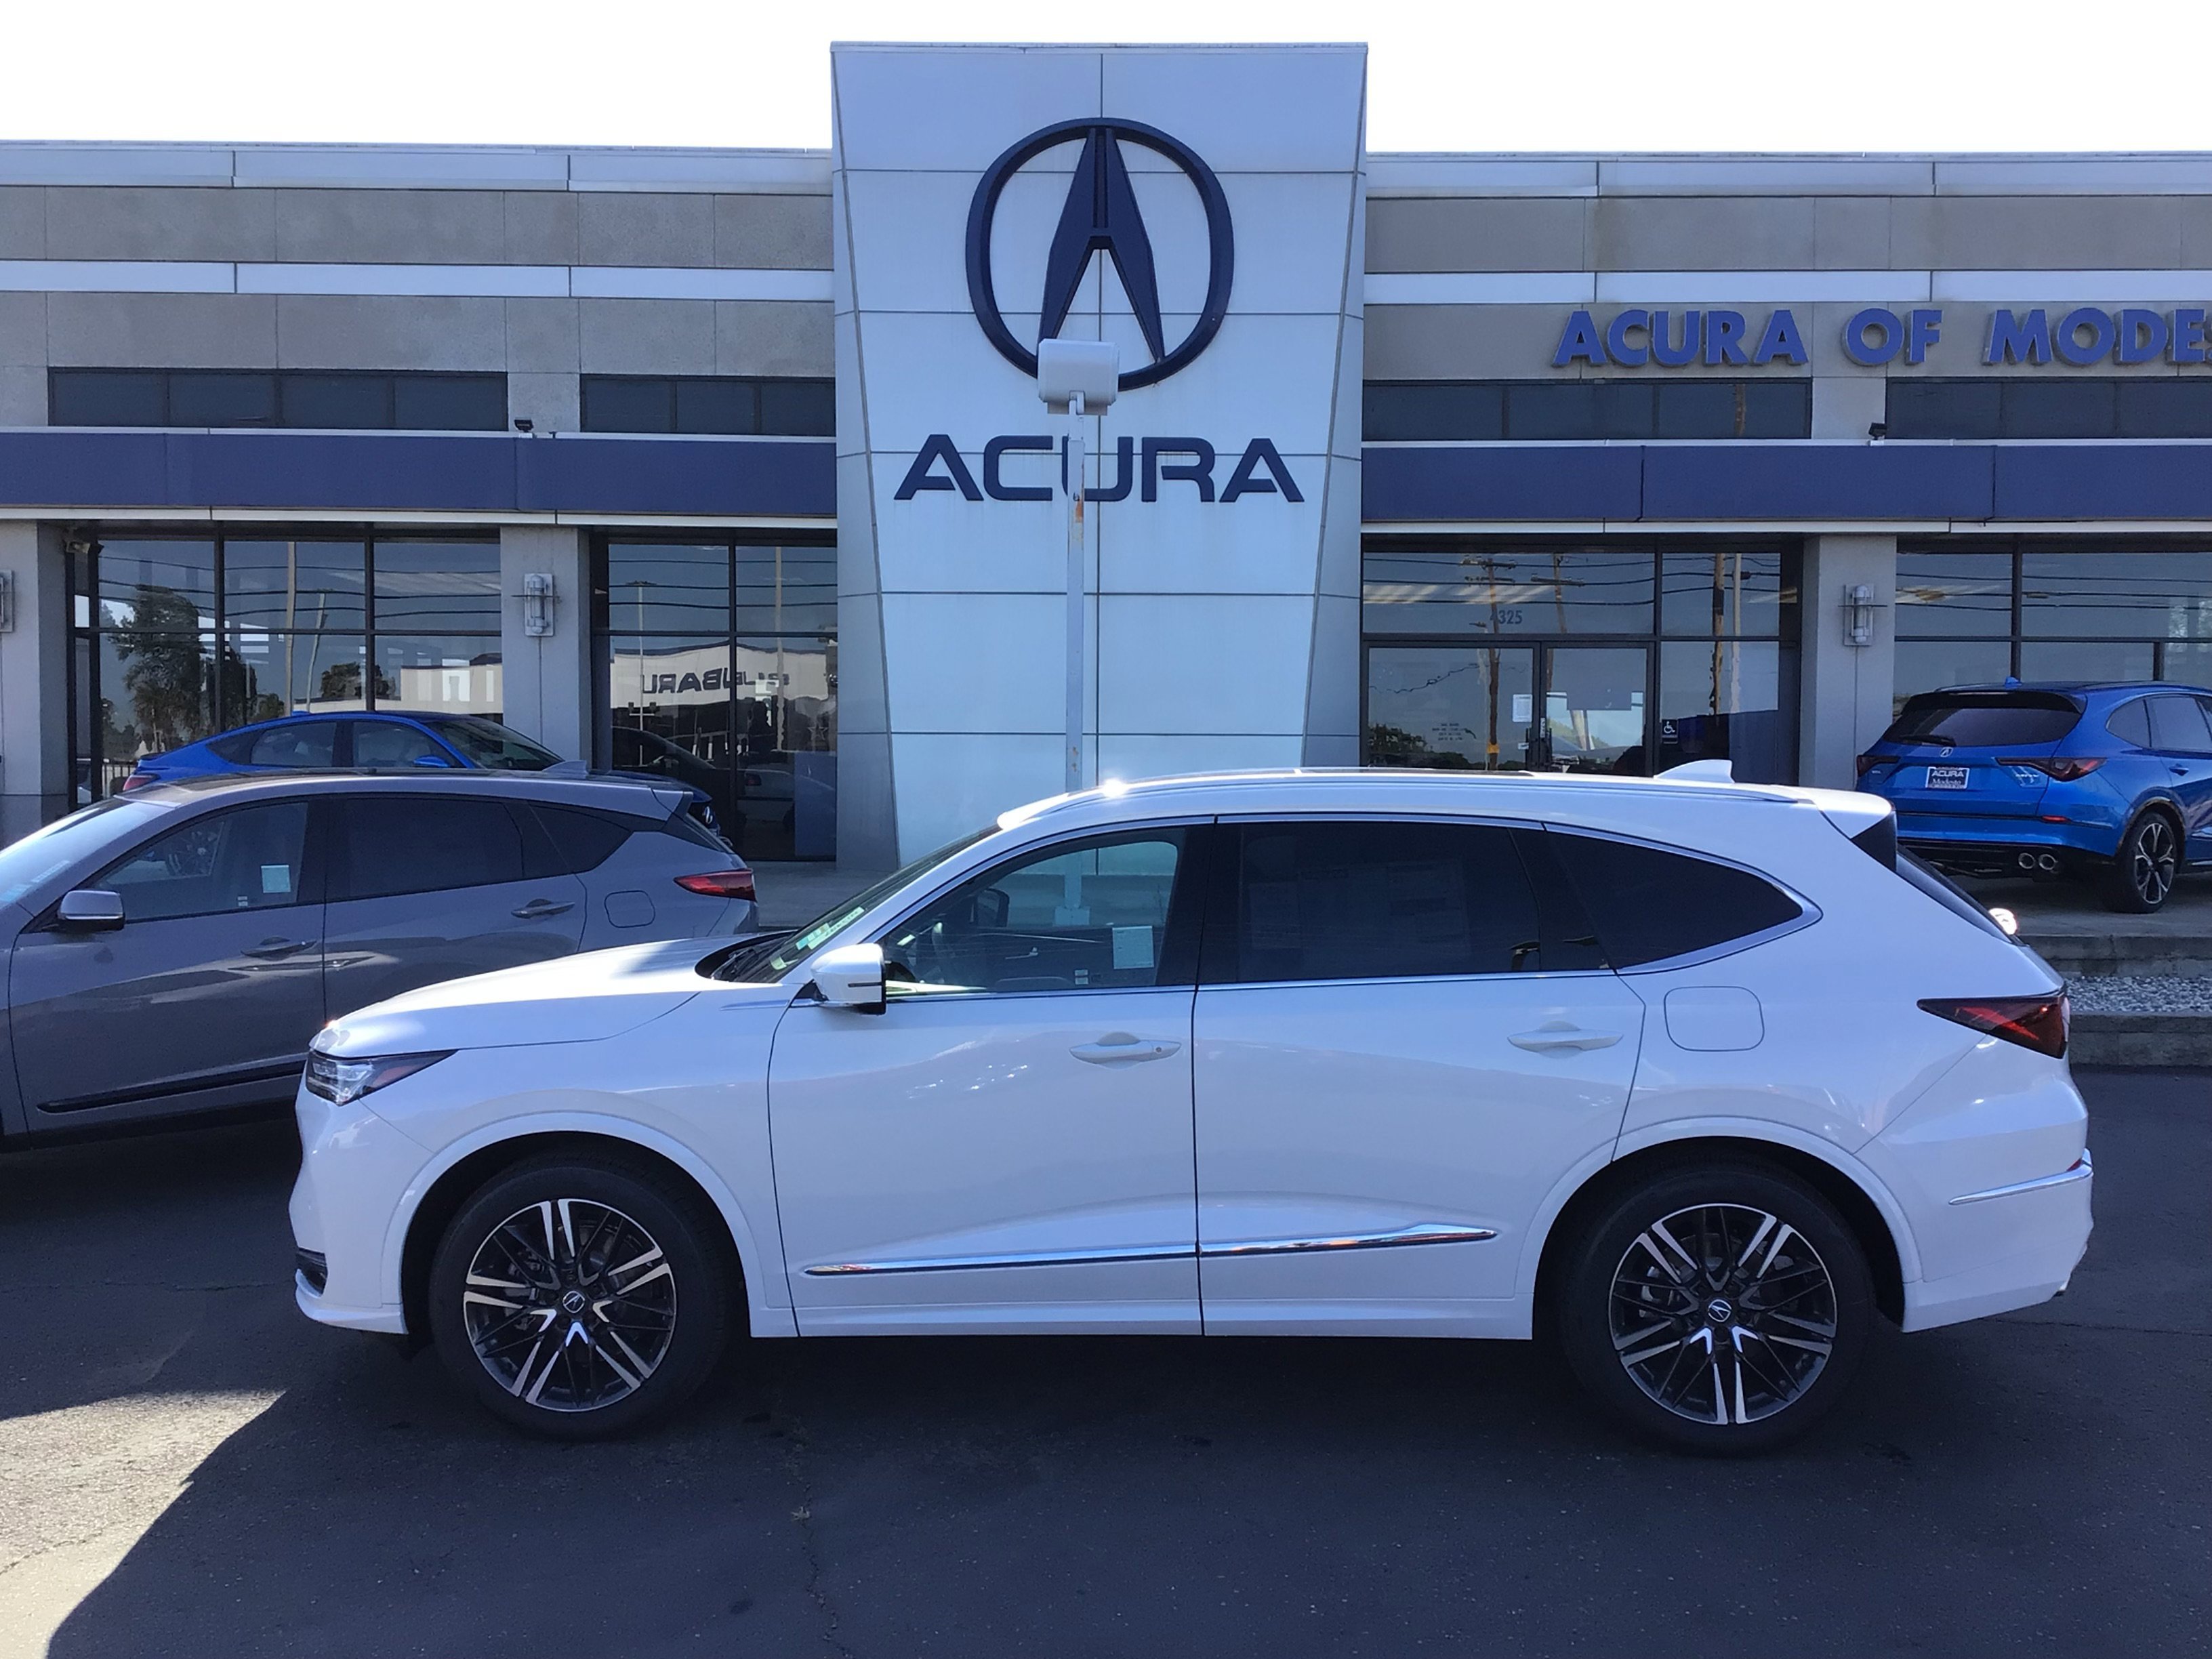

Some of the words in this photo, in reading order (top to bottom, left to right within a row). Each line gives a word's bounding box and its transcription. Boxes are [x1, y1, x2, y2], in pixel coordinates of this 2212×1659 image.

[1551, 309, 1809, 367] ACURA
[1842, 307, 1943, 366] OF
[1984, 308, 2212, 365] MODE
[893, 434, 1305, 503] ACURA
